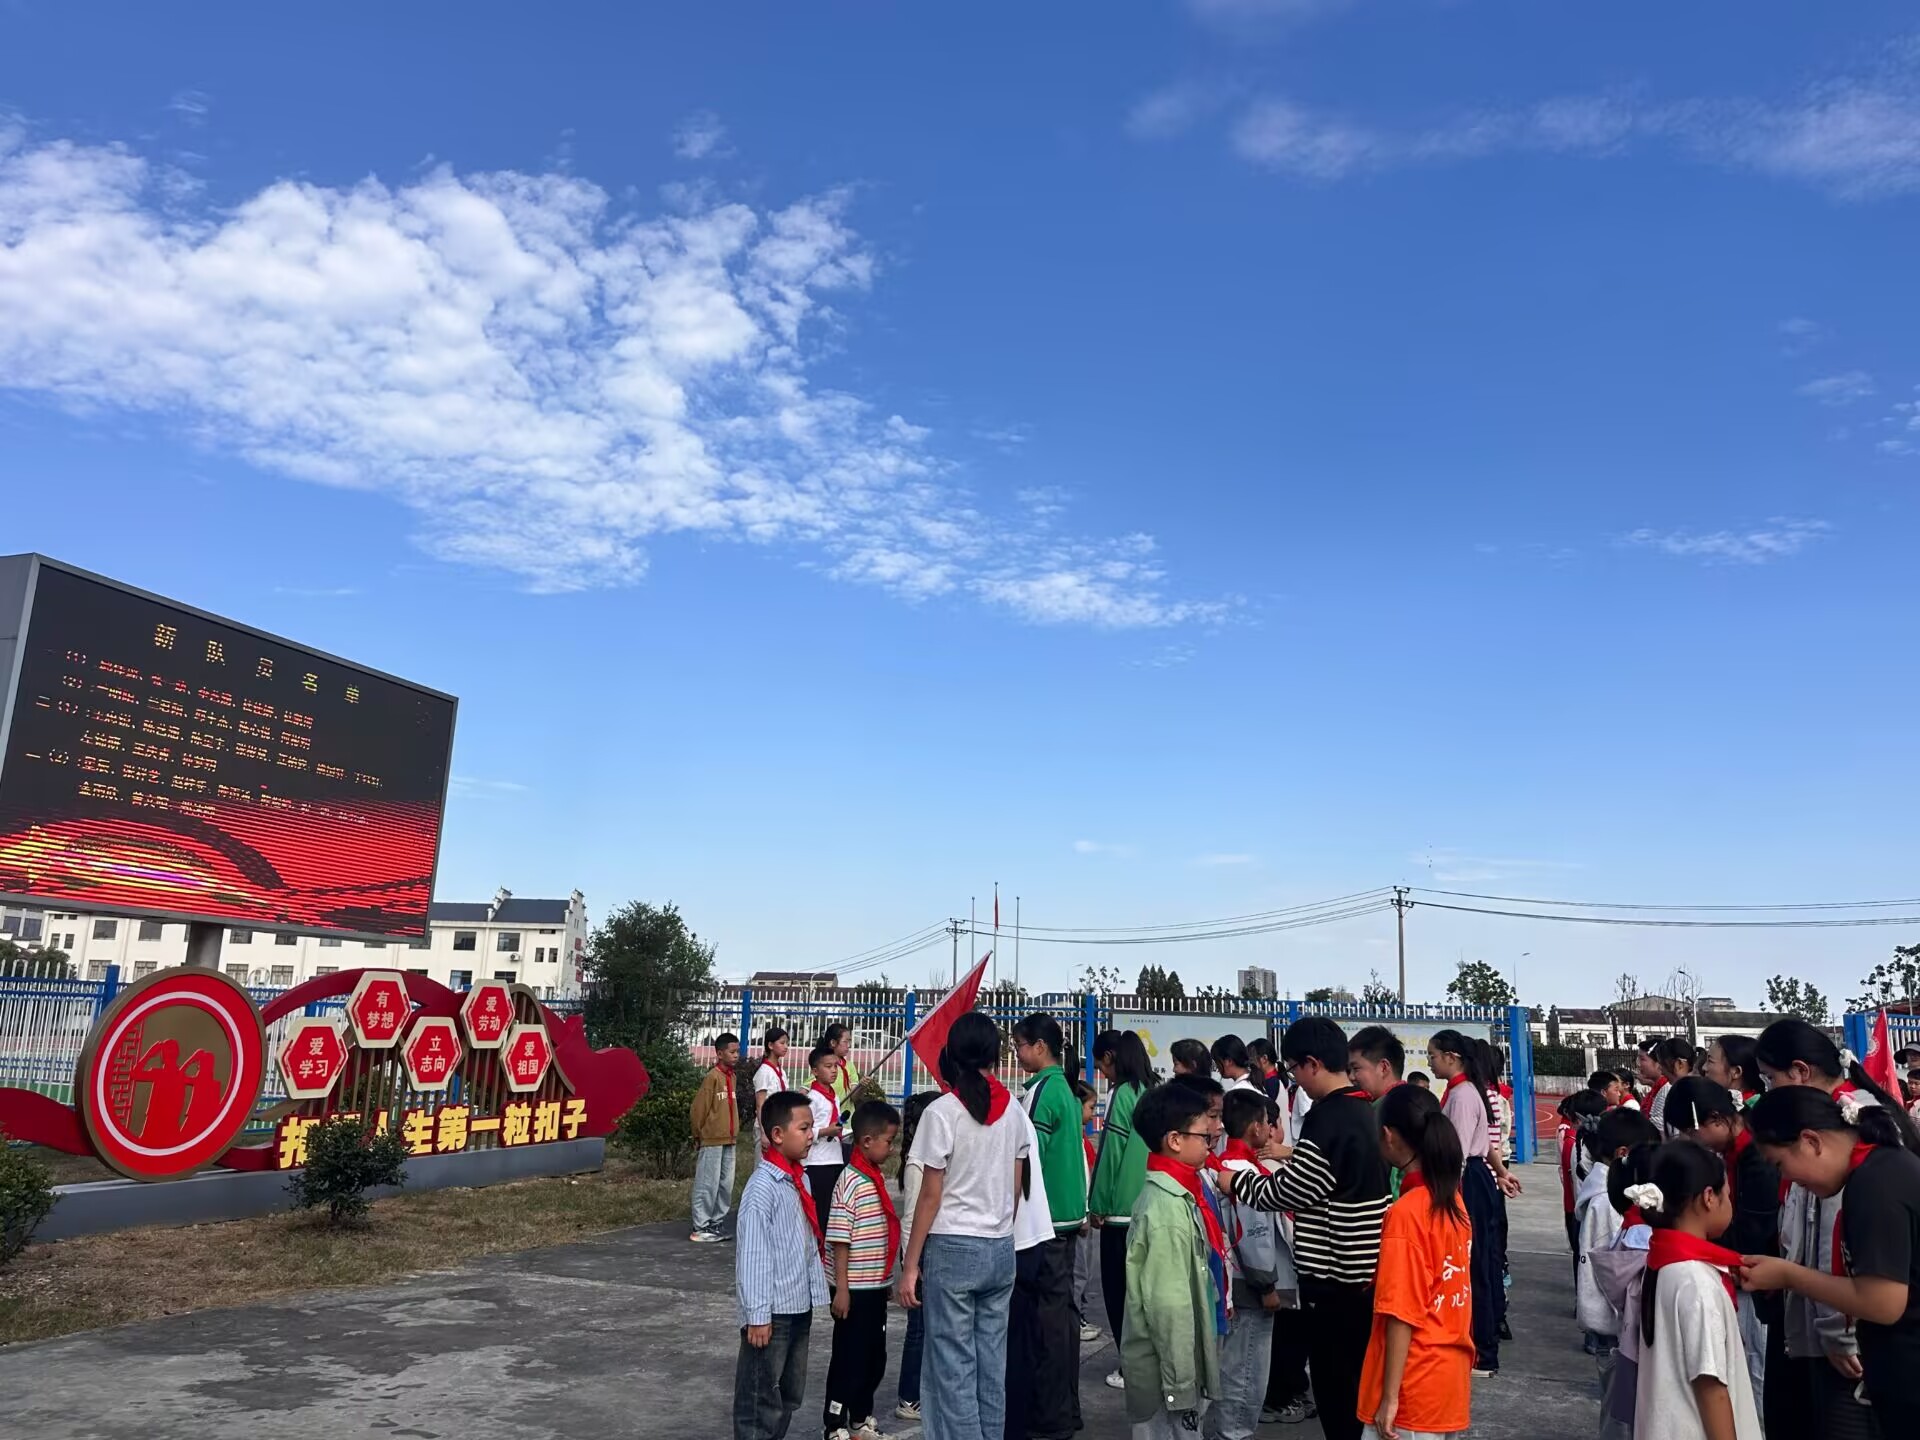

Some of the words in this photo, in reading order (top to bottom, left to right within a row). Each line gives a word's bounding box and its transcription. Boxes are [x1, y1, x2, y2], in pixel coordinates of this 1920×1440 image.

[154, 623, 361, 705] 新队员名单
[376, 990, 390, 1008] 有
[485, 996, 497, 1012] 爱
[367, 1011, 394, 1029] 梦想
[478, 1015, 500, 1031] 劳动
[309, 1037, 324, 1055] 爱
[429, 1036, 441, 1052] 立
[524, 1041, 535, 1057] 爱
[299, 1059, 329, 1079] 学习
[420, 1055, 446, 1072] 志向
[517, 1059, 539, 1075] 祖国
